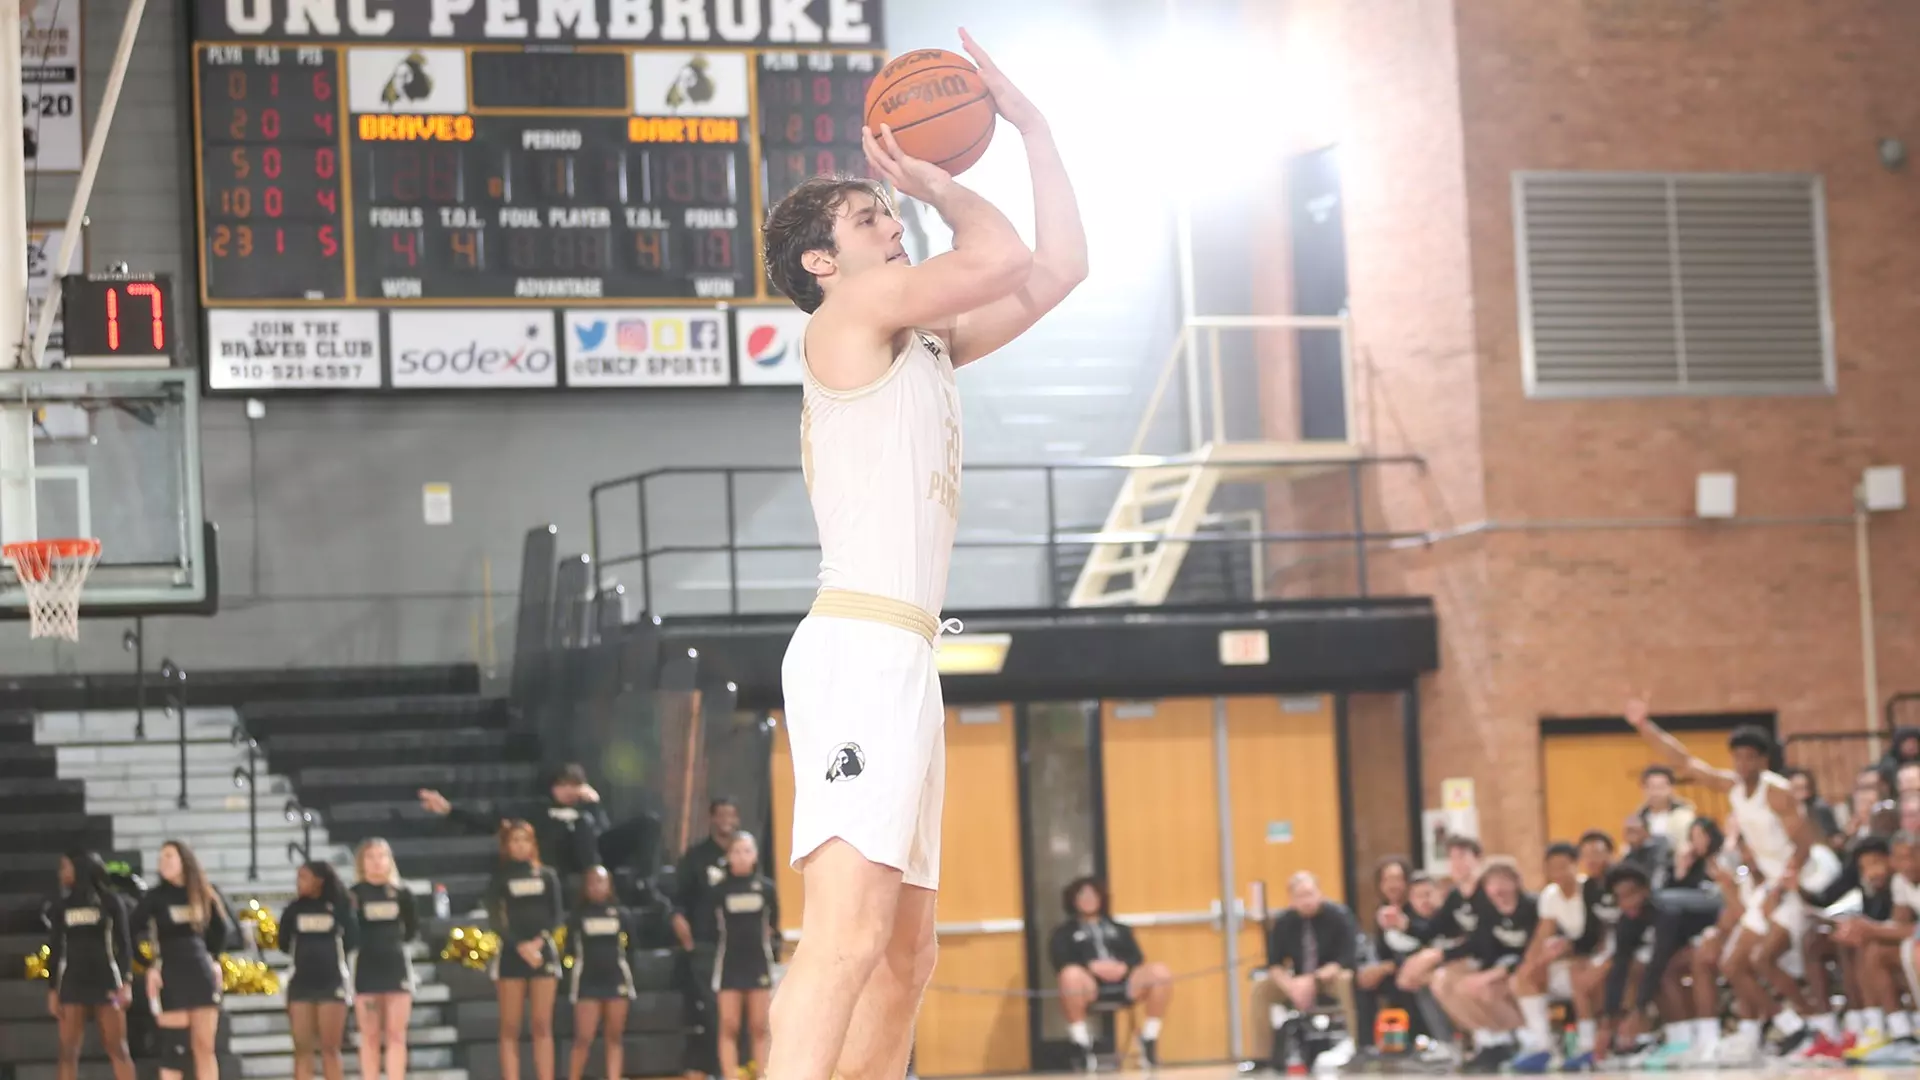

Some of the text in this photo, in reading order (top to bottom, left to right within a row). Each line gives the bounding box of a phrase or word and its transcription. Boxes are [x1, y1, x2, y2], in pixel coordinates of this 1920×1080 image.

[226, 0, 872, 43] UNC PEMBROKE
[228, 69, 331, 101] 0 1 6
[881, 74, 969, 114] Wilson
[230, 107, 333, 140] 2 0 4
[358, 114, 475, 142] BRAVES
[522, 129, 582, 150] PERIOD
[231, 146, 335, 179] 5 0 0
[222, 186, 336, 218] 10 0 4
[369, 206, 424, 228] FOULS
[498, 207, 611, 229] FOUL PLAYER
[684, 207, 738, 229] FOULS
[212, 223, 338, 257] 23 1 5
[391, 230, 417, 268] 4
[451, 231, 477, 268] 4
[635, 231, 661, 268] 4
[381, 277, 423, 298] WON
[514, 277, 603, 298] ADVANTAGE
[694, 277, 735, 298] WON
[106, 282, 163, 351] 17
[250, 321, 340, 336] JOIN THE
[221, 339, 373, 358] BRAVES CLUB
[397, 340, 553, 375] sodexo
[573, 356, 723, 377] @UNCP SPORTS
